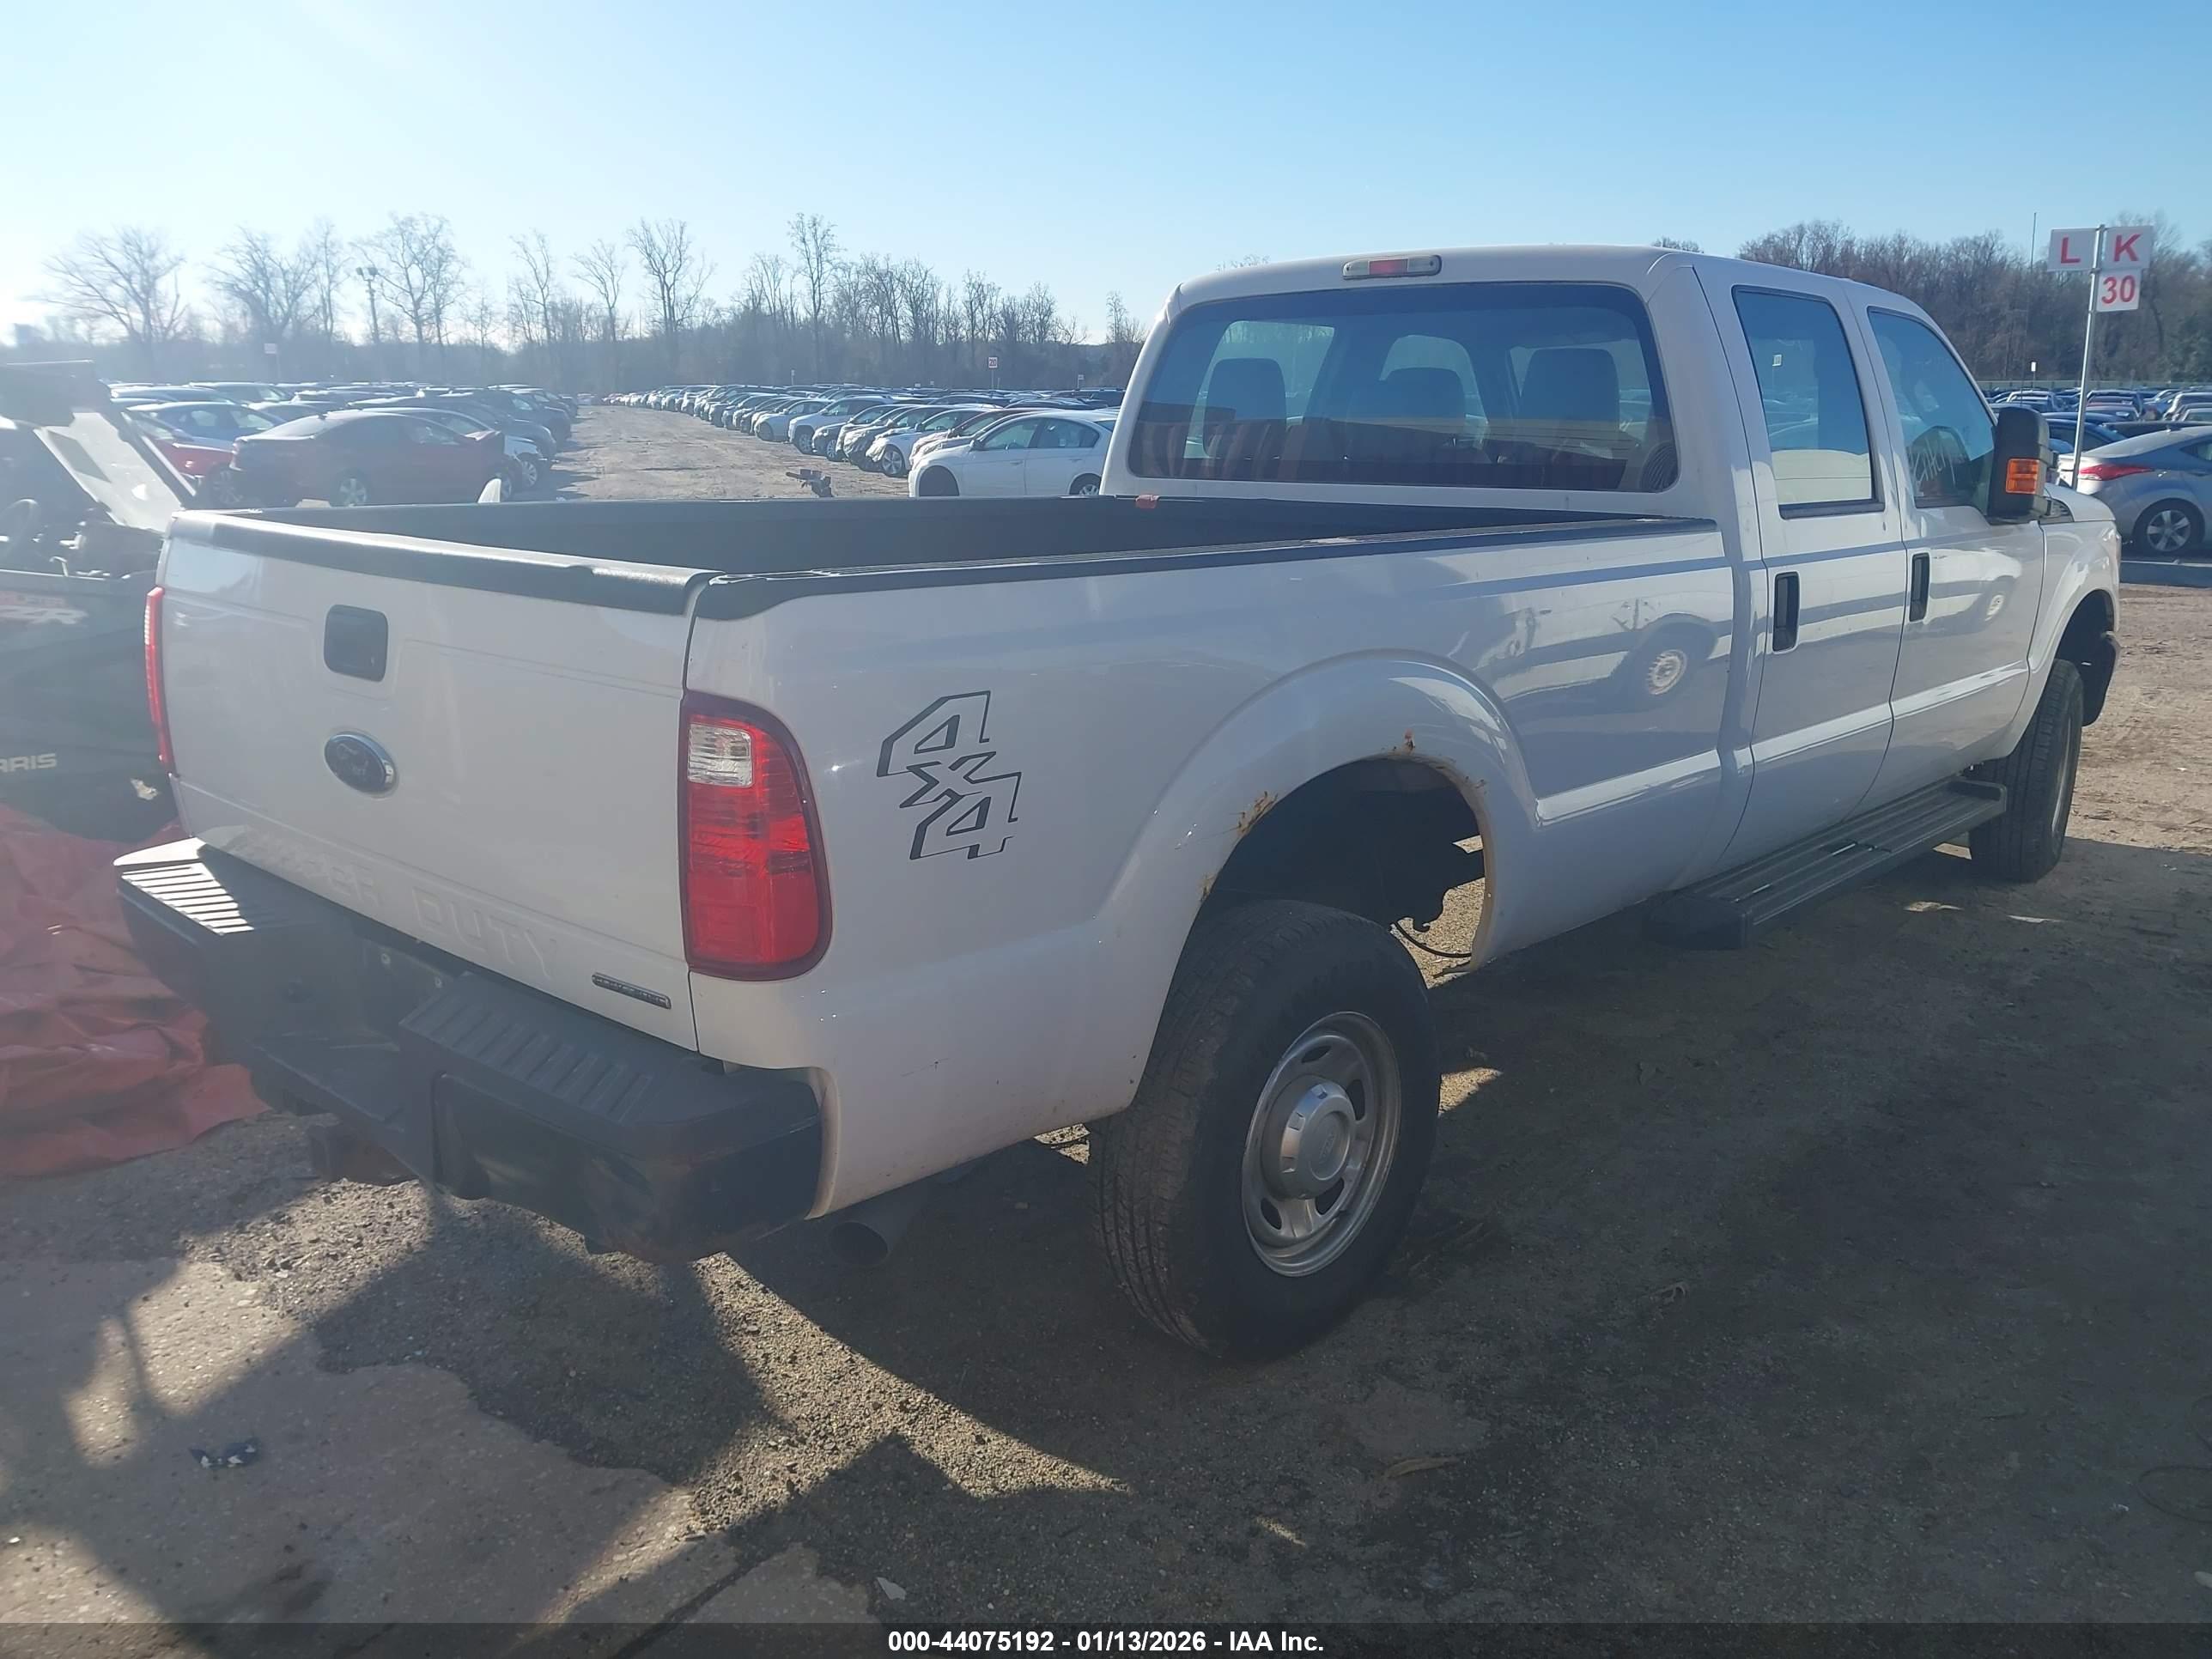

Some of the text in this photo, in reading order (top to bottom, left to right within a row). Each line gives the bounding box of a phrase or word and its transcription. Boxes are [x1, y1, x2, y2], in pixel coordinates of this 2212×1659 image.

[2060, 237, 2081, 264] L
[2113, 234, 2142, 263] K
[2101, 275, 2136, 304] 30
[412, 885, 558, 981] DUTY
